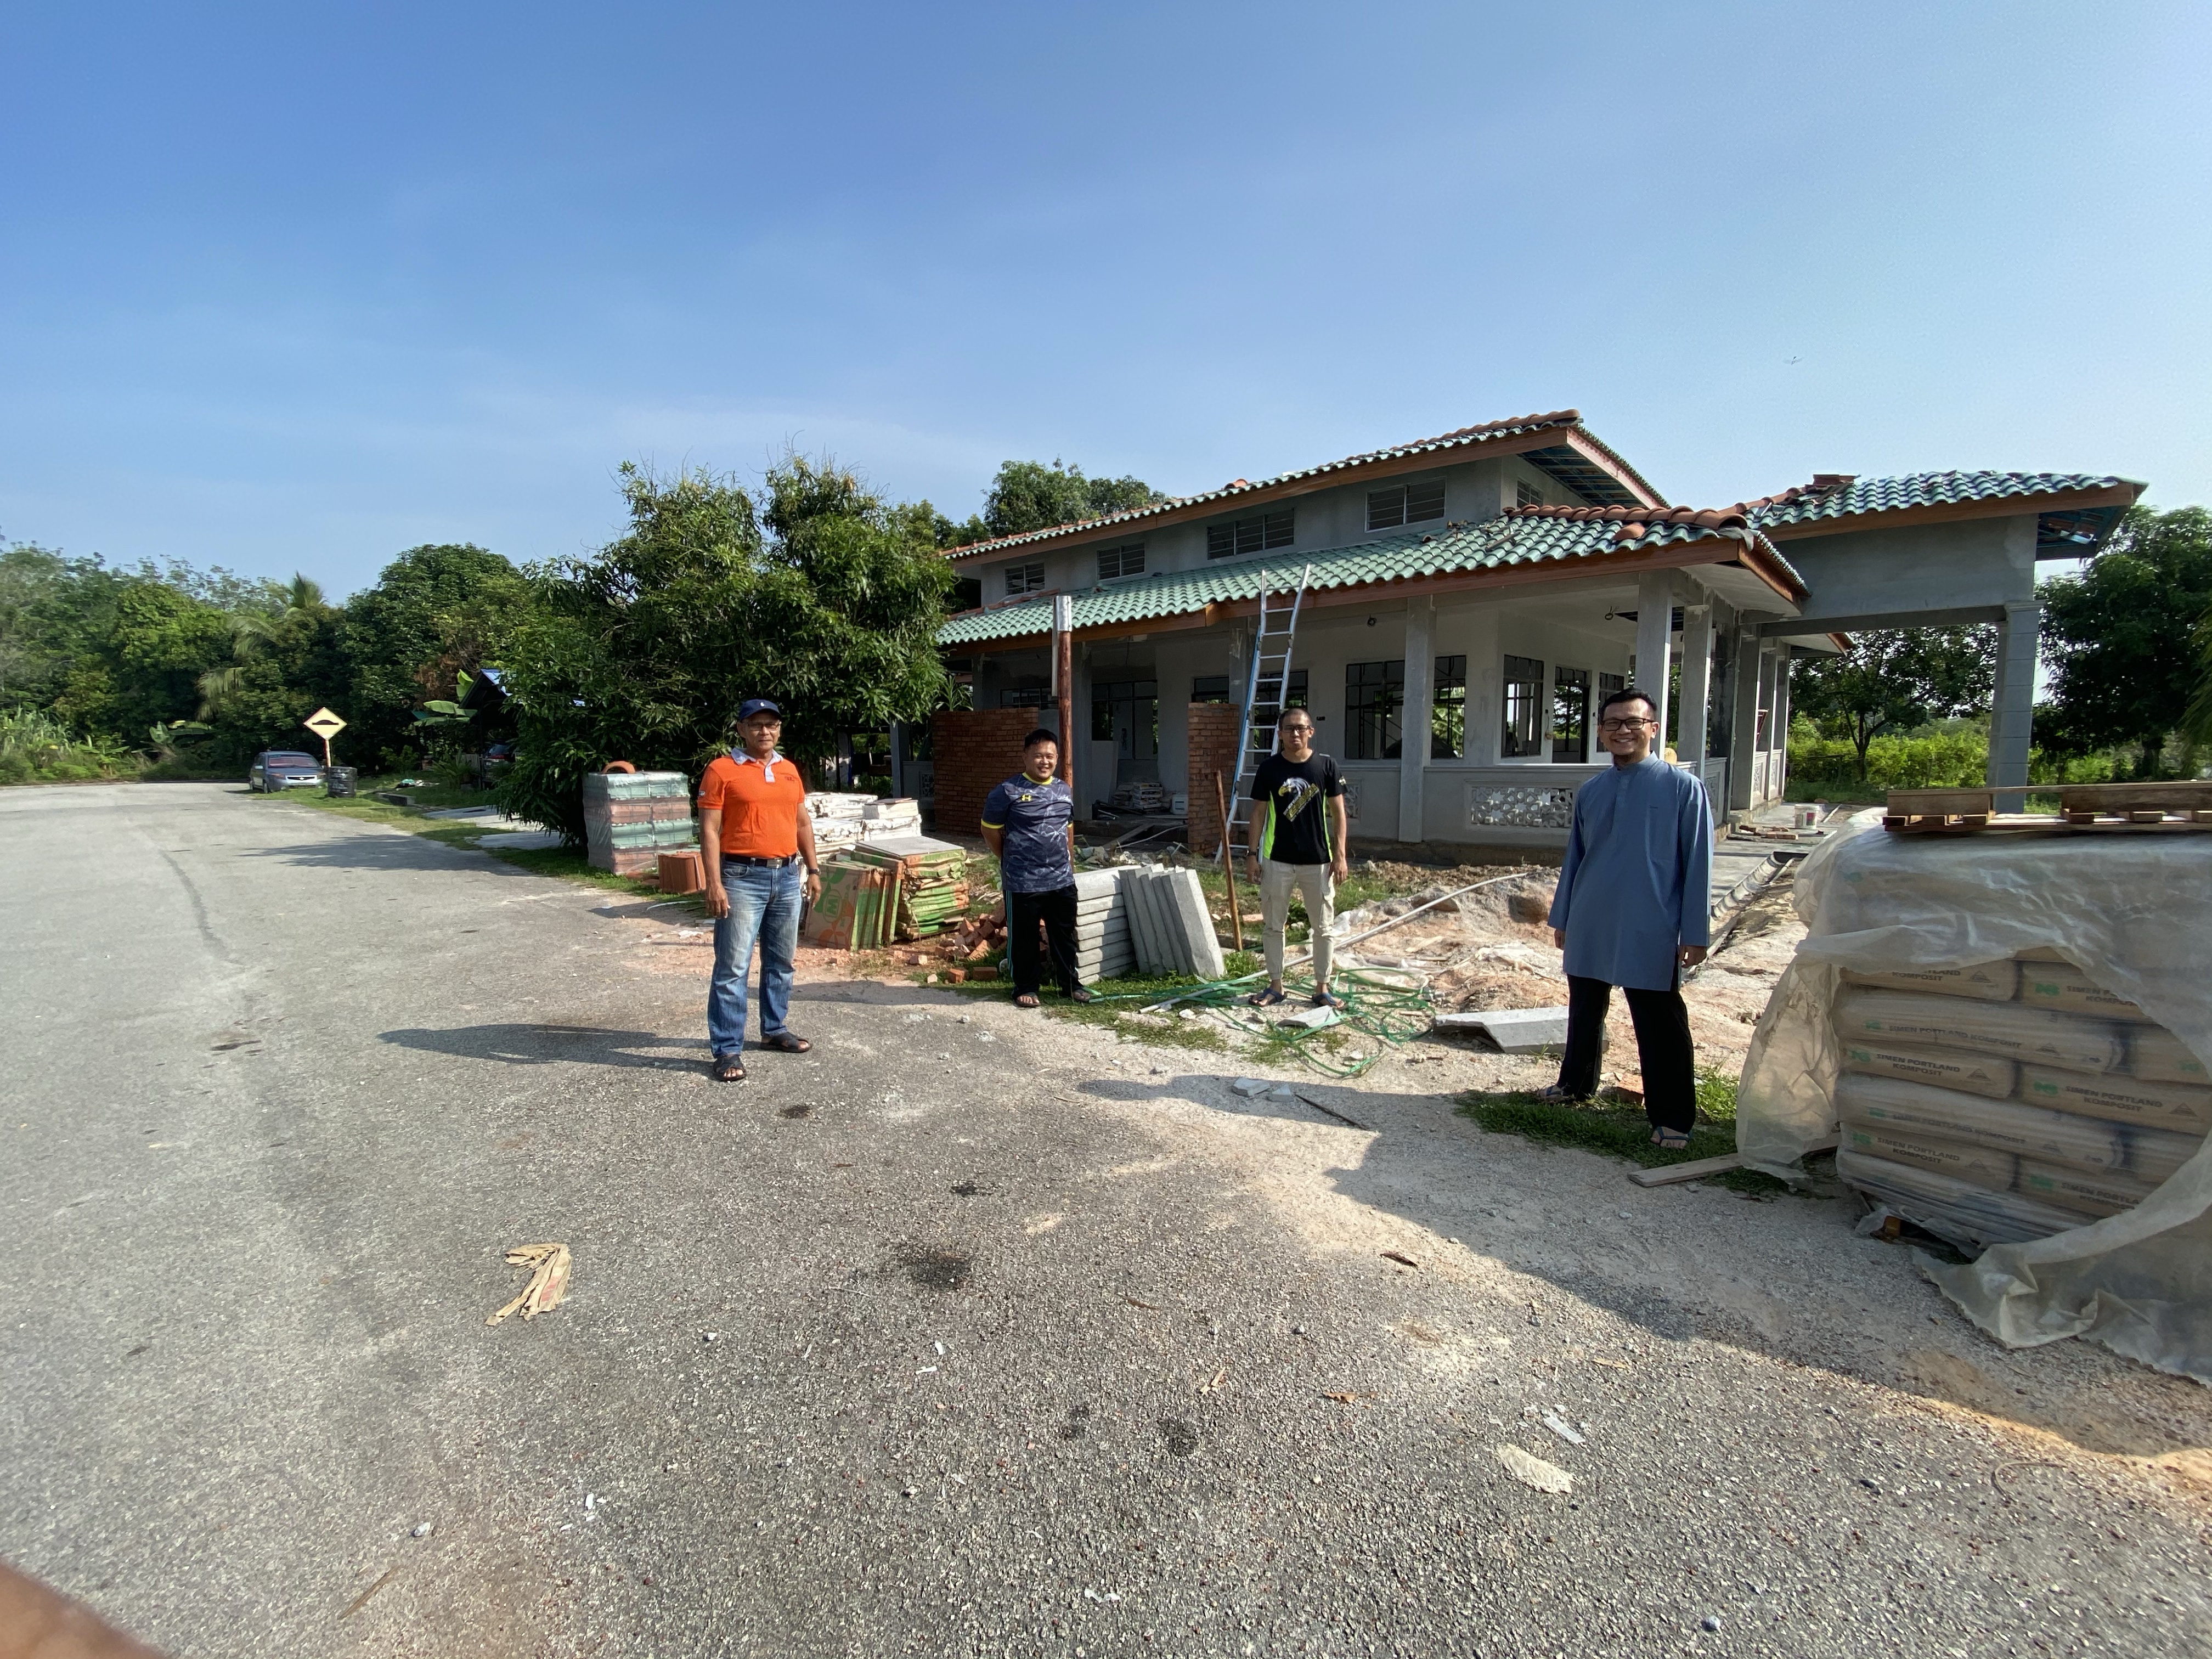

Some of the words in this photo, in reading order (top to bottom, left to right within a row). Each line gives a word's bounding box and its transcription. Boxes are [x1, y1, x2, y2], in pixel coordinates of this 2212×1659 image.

[1892, 972, 1943, 981] KOMPOSIT
[2066, 985, 2101, 995] SIMEN
[1919, 1027, 1968, 1039] PORTLAND
[1971, 1034, 2022, 1048] KOMPOSIT
[1877, 1053, 1906, 1063] SIMEN
[1907, 1058, 1961, 1073] PORTLAND
[1893, 1063, 1942, 1076] KOMPOSIT
[2066, 1086, 2099, 1097] SIMEN
[2102, 1092, 2163, 1107] PORTLAND
[2084, 1097, 2142, 1111] KOMPOSIT
[1877, 1137, 1905, 1148] SIMEN
[1908, 1144, 1960, 1161] PORTLAND
[1893, 1148, 1942, 1164] KOMPOSIT
[2061, 1182, 2095, 1195] SIMEN
